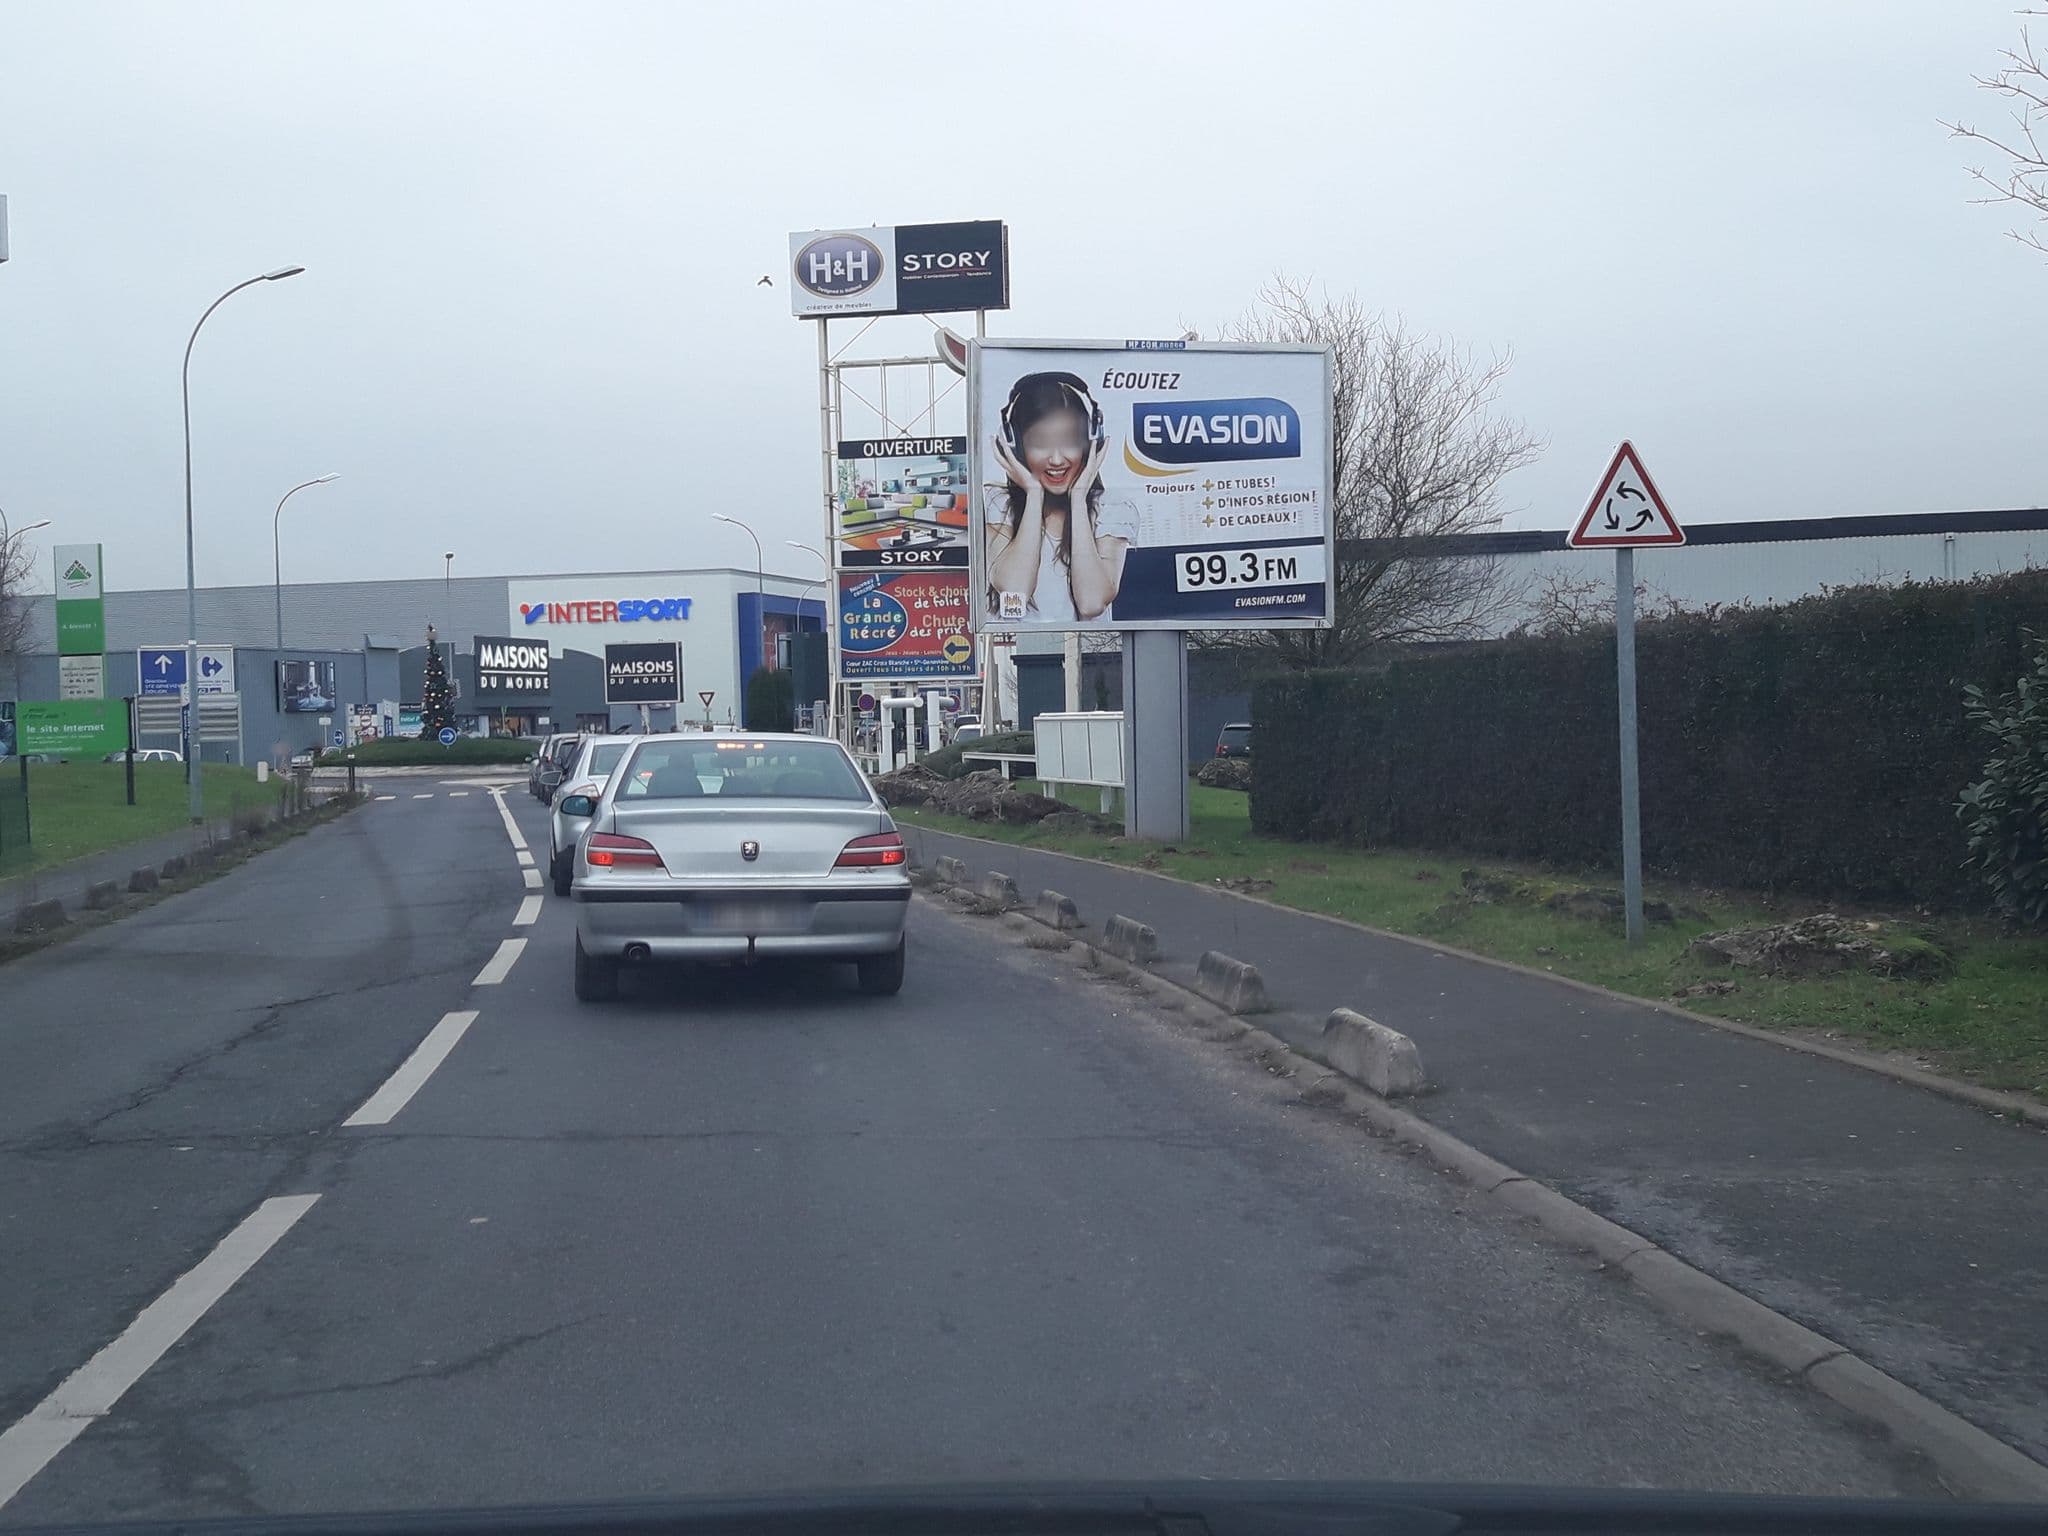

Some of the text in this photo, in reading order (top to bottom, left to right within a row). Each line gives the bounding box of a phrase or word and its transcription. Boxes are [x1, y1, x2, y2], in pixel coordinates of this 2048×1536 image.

[809, 250, 869, 284] H&H
[902, 250, 991, 272] STORY
[1102, 368, 1181, 389] ÉCOUTEZ
[1143, 414, 1288, 444] EVASION
[863, 438, 953, 457] OUVERTURE
[1145, 483, 1196, 495] Toujours
[1217, 480, 1232, 490] DE
[1218, 496, 1264, 509] D'INFOS
[1219, 516, 1234, 526] DE
[880, 550, 943, 564] STORY
[1185, 552, 1297, 586] 99.3 FM
[894, 586, 926, 598] Stock
[928, 586, 937, 597] &
[863, 597, 881, 609] La
[914, 599, 930, 609] de
[933, 595, 961, 608] folie
[1234, 593, 1307, 608] EVASIONFM.COM
[547, 598, 693, 624] INTERSPORT
[843, 611, 902, 624] Grande
[922, 614, 966, 628] Chute
[850, 625, 897, 639] Récré
[909, 627, 932, 637] des
[937, 625, 962, 640] prix
[479, 644, 549, 670] MAISONS
[609, 660, 675, 675] MAISONS
[904, 666, 923, 674] jours
[937, 664, 949, 672] 10h
[480, 675, 549, 690] DU MONDE
[633, 676, 675, 685] MONDE
[26, 723, 105, 733] le site internet
